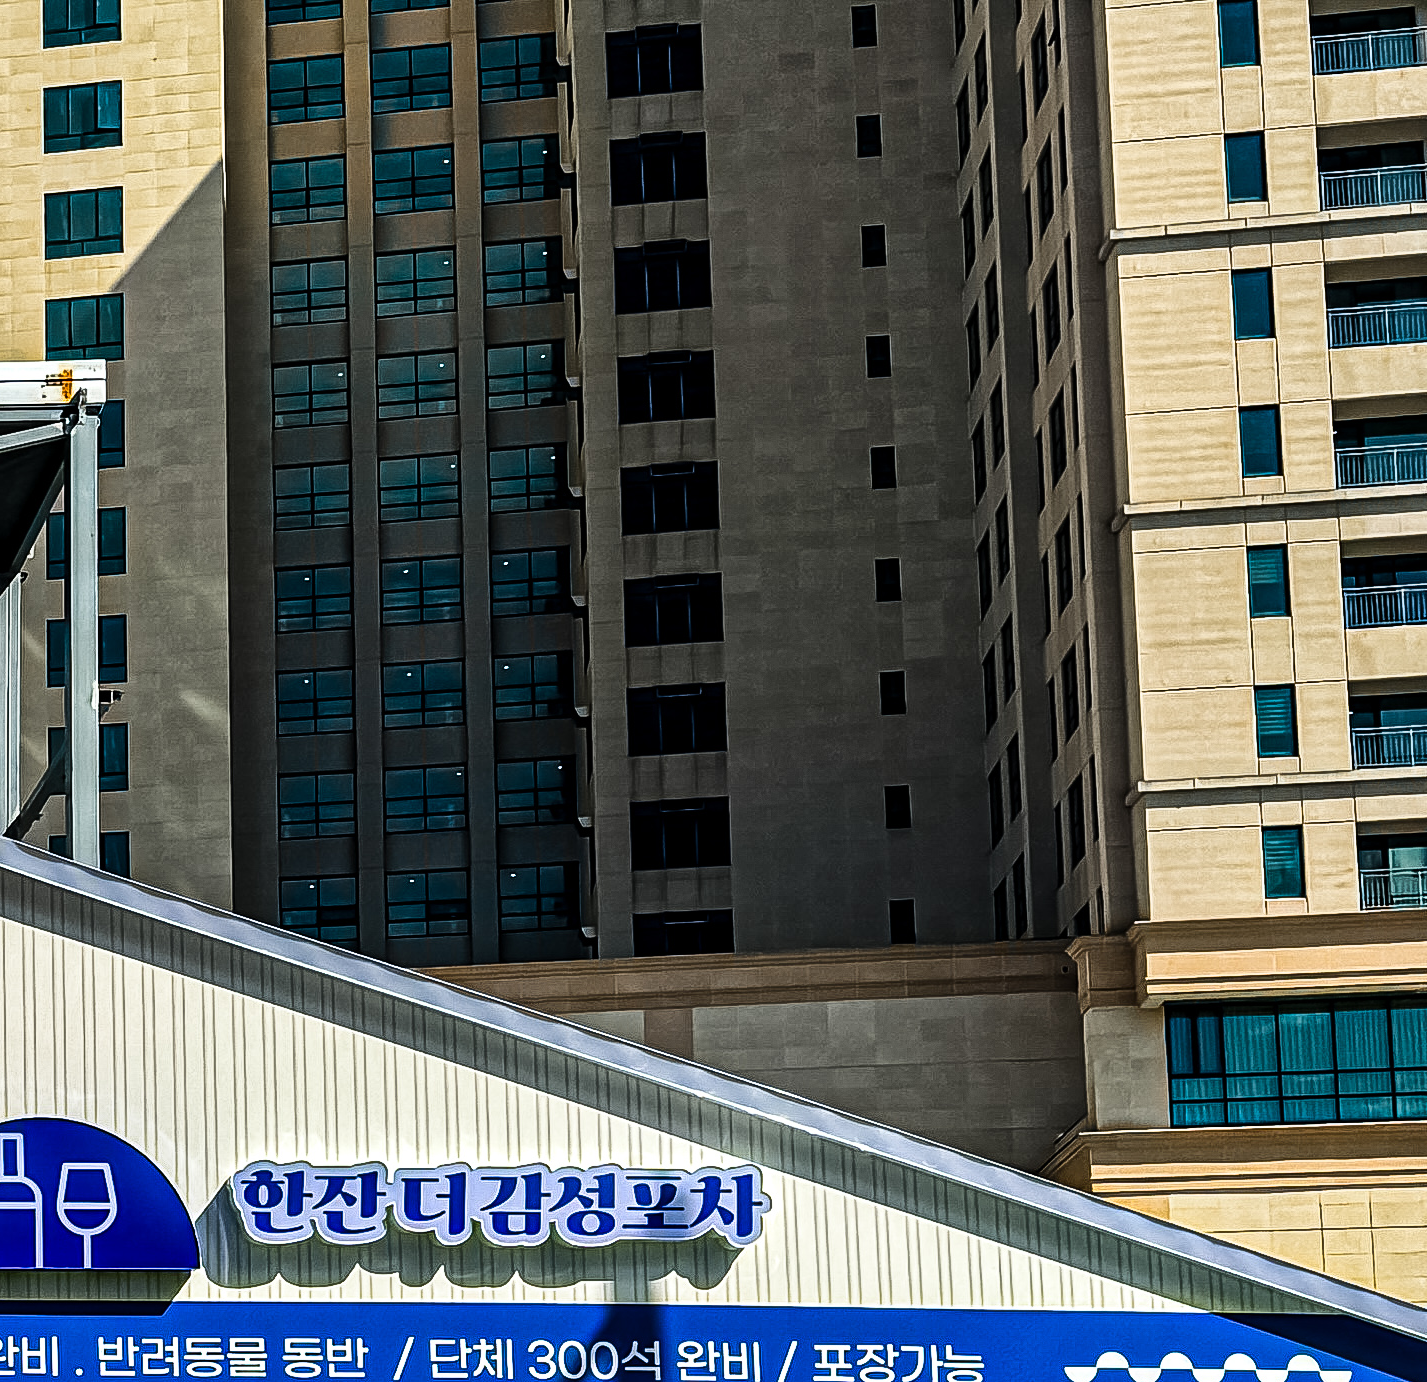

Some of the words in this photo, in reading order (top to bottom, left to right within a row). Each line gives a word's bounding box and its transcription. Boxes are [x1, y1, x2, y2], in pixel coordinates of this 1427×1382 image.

[97, 1336, 268, 1377] 반려동물
[281, 1337, 369, 1379] 동반
[429, 1338, 514, 1380] 단체
[527, 1339, 661, 1381] 300석
[676, 1340, 761, 1382] 완비
